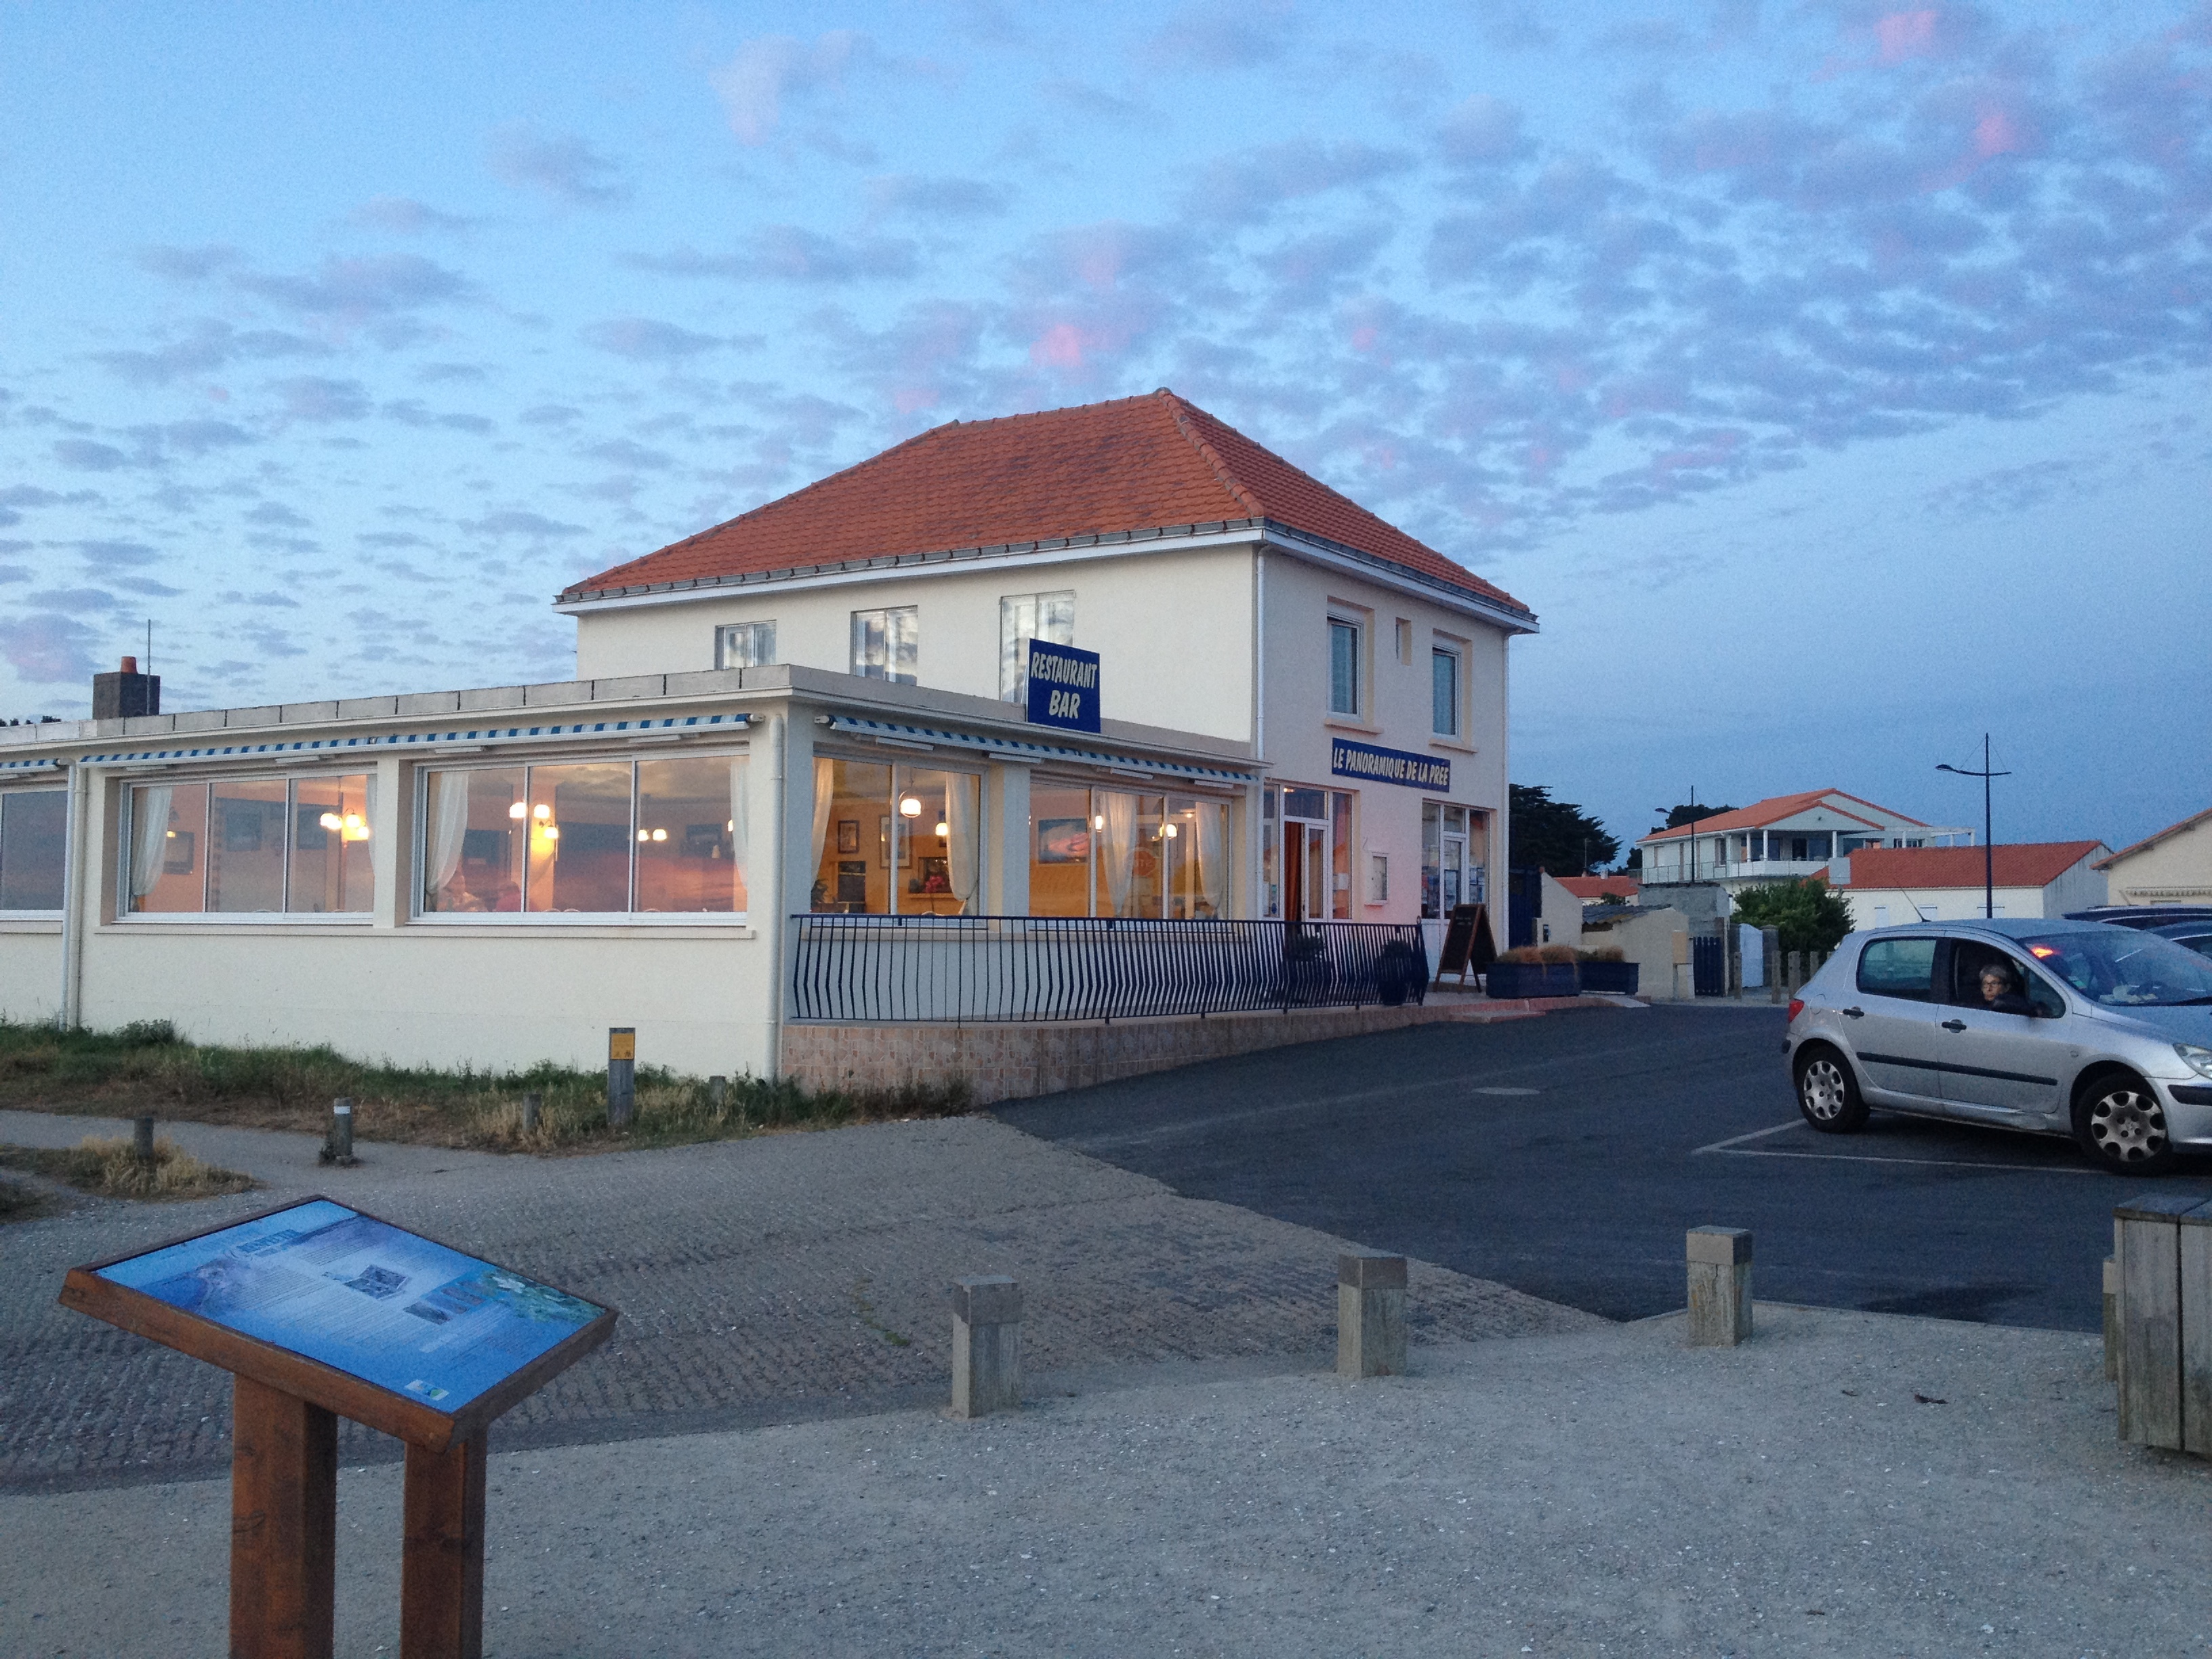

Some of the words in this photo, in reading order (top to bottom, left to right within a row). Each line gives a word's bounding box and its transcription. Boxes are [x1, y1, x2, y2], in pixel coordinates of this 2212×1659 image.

[1031, 652, 1097, 689] RESTAURANT
[1049, 690, 1080, 719] BAR
[1333, 747, 1344, 769] LE
[1346, 750, 1406, 779] PANORAMIQUE
[1406, 760, 1416, 781] DE
[1418, 762, 1428, 783] LA
